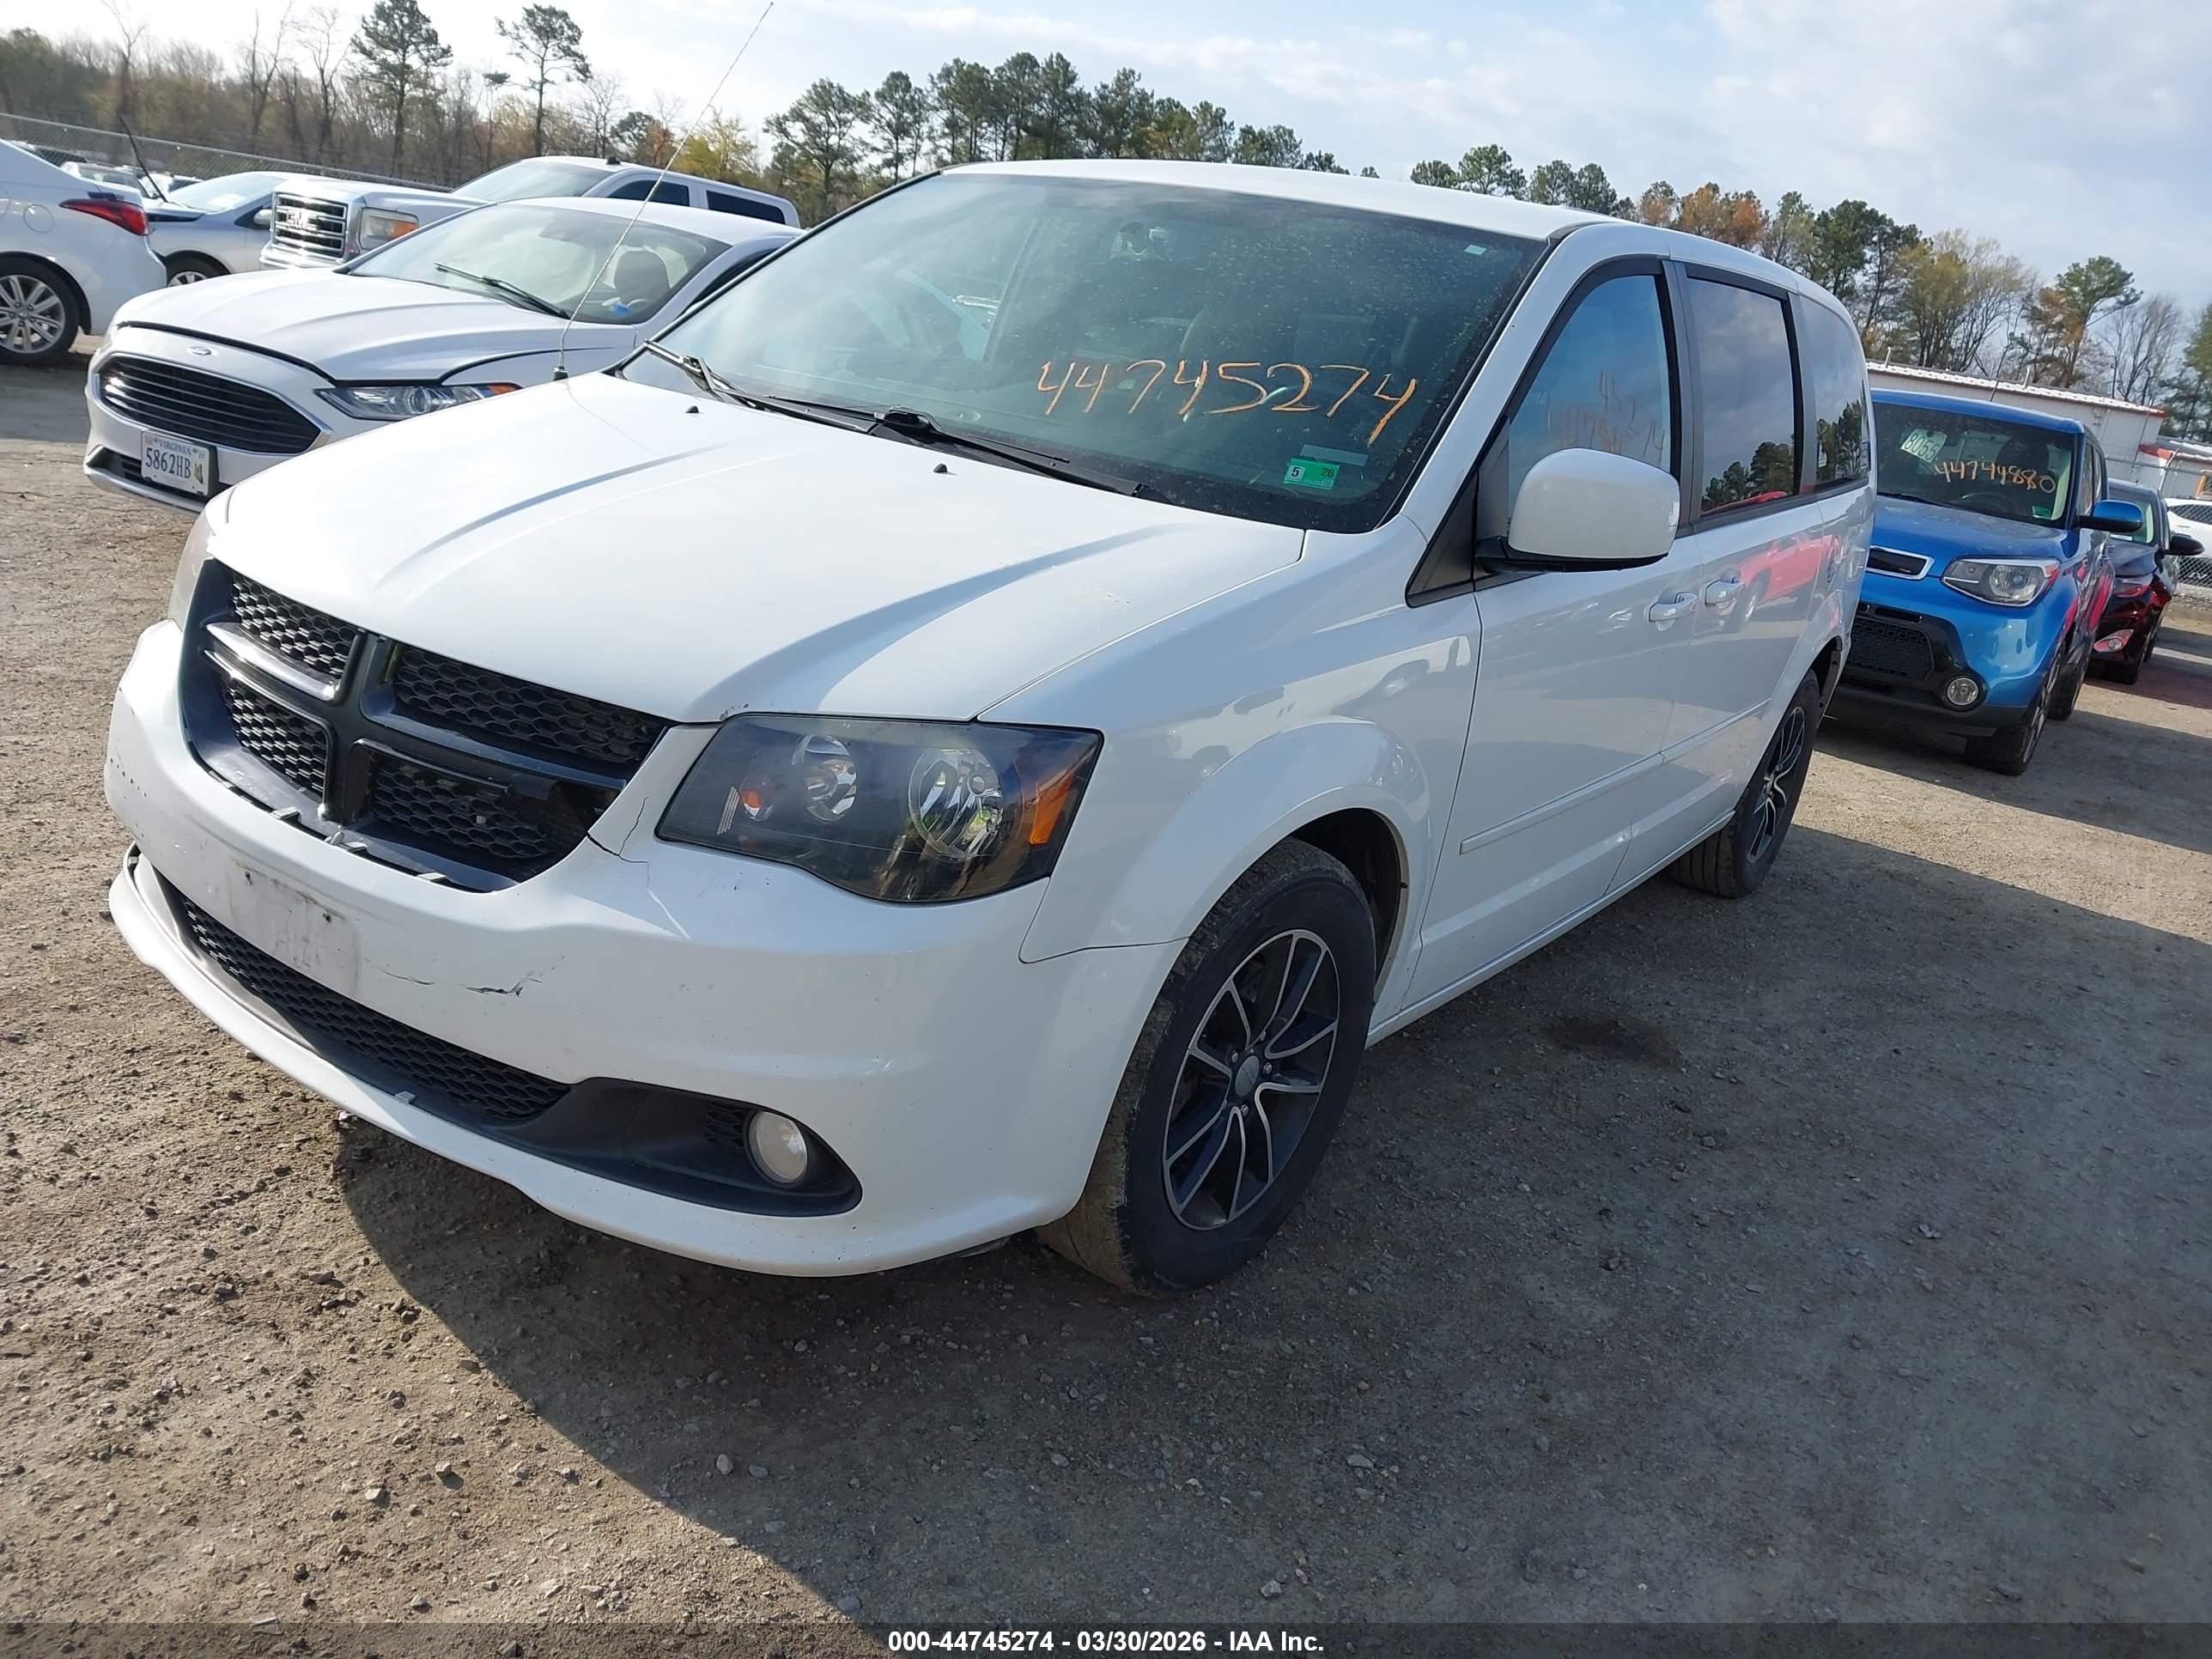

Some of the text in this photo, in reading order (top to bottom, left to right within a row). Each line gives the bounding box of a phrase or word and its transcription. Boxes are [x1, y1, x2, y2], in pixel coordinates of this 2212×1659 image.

[1037, 359, 1417, 447] 44745274
[158, 439, 191, 455] VIRGINIA
[1904, 433, 1941, 461] 8055
[146, 447, 191, 479] 5862HB
[1291, 466, 1335, 477] 5 26
[1934, 460, 2057, 494] 44744880
